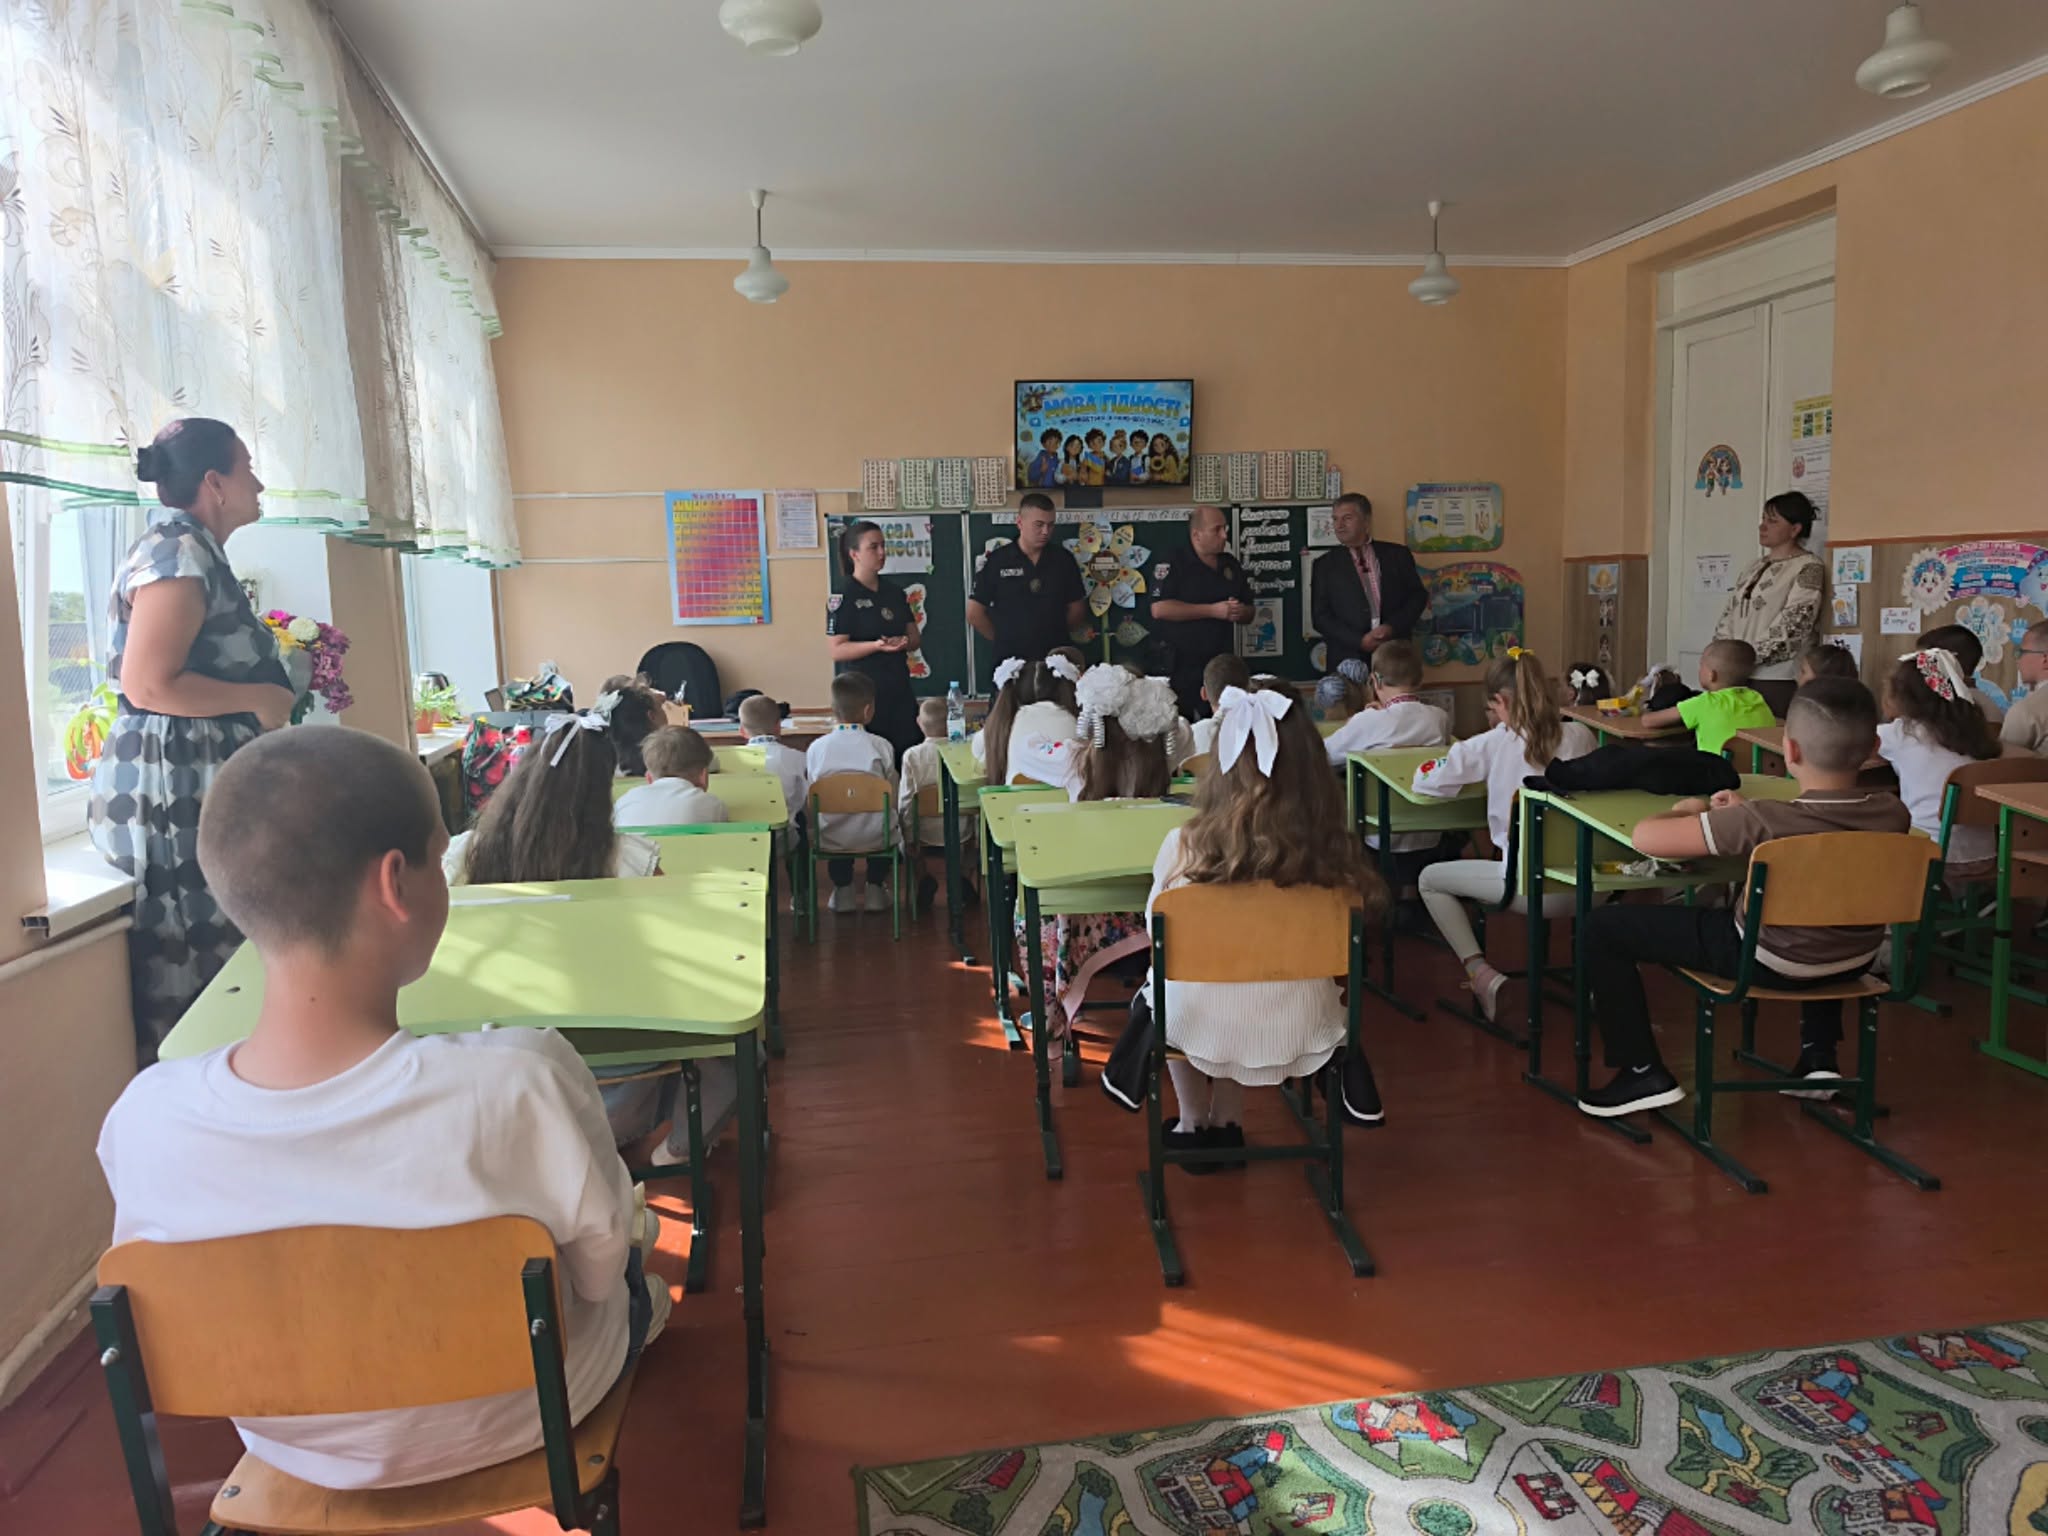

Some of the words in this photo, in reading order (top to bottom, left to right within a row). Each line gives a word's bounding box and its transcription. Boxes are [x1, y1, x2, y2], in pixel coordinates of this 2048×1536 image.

[1044, 394, 1096, 418] МОВА
[1102, 393, 1181, 418] ГІДНОСТІ
[692, 492, 737, 500] Numbers
